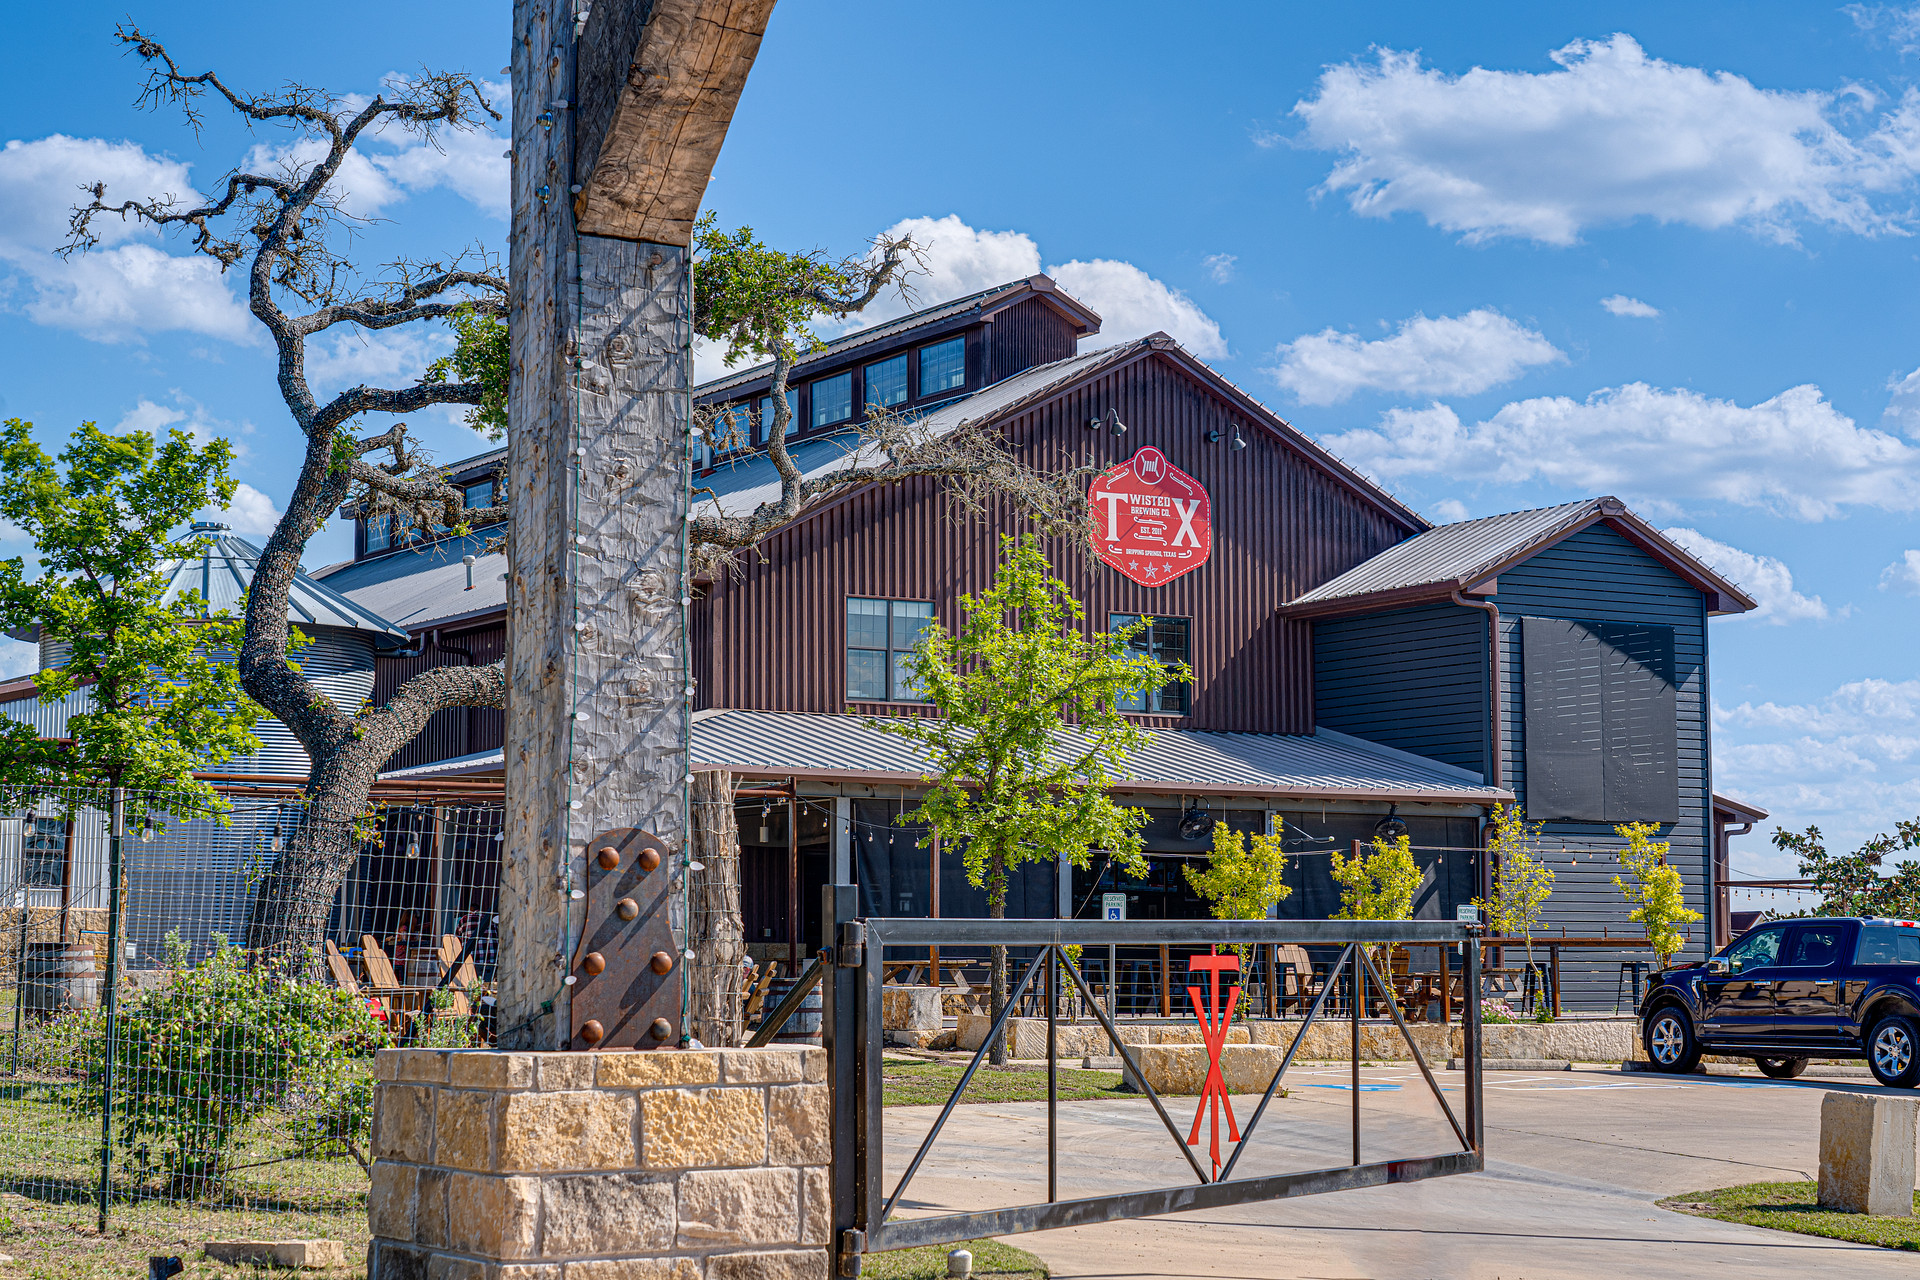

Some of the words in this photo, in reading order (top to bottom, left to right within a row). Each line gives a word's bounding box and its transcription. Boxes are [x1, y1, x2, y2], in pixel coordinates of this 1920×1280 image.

[1130, 506, 1160, 515] BREWING
[1161, 509, 1171, 517] CO.
[1171, 497, 1202, 548] X
[1140, 526, 1150, 534] EST.
[1151, 527, 1162, 535] 2011
[1145, 549, 1163, 557] SPRINGS,
